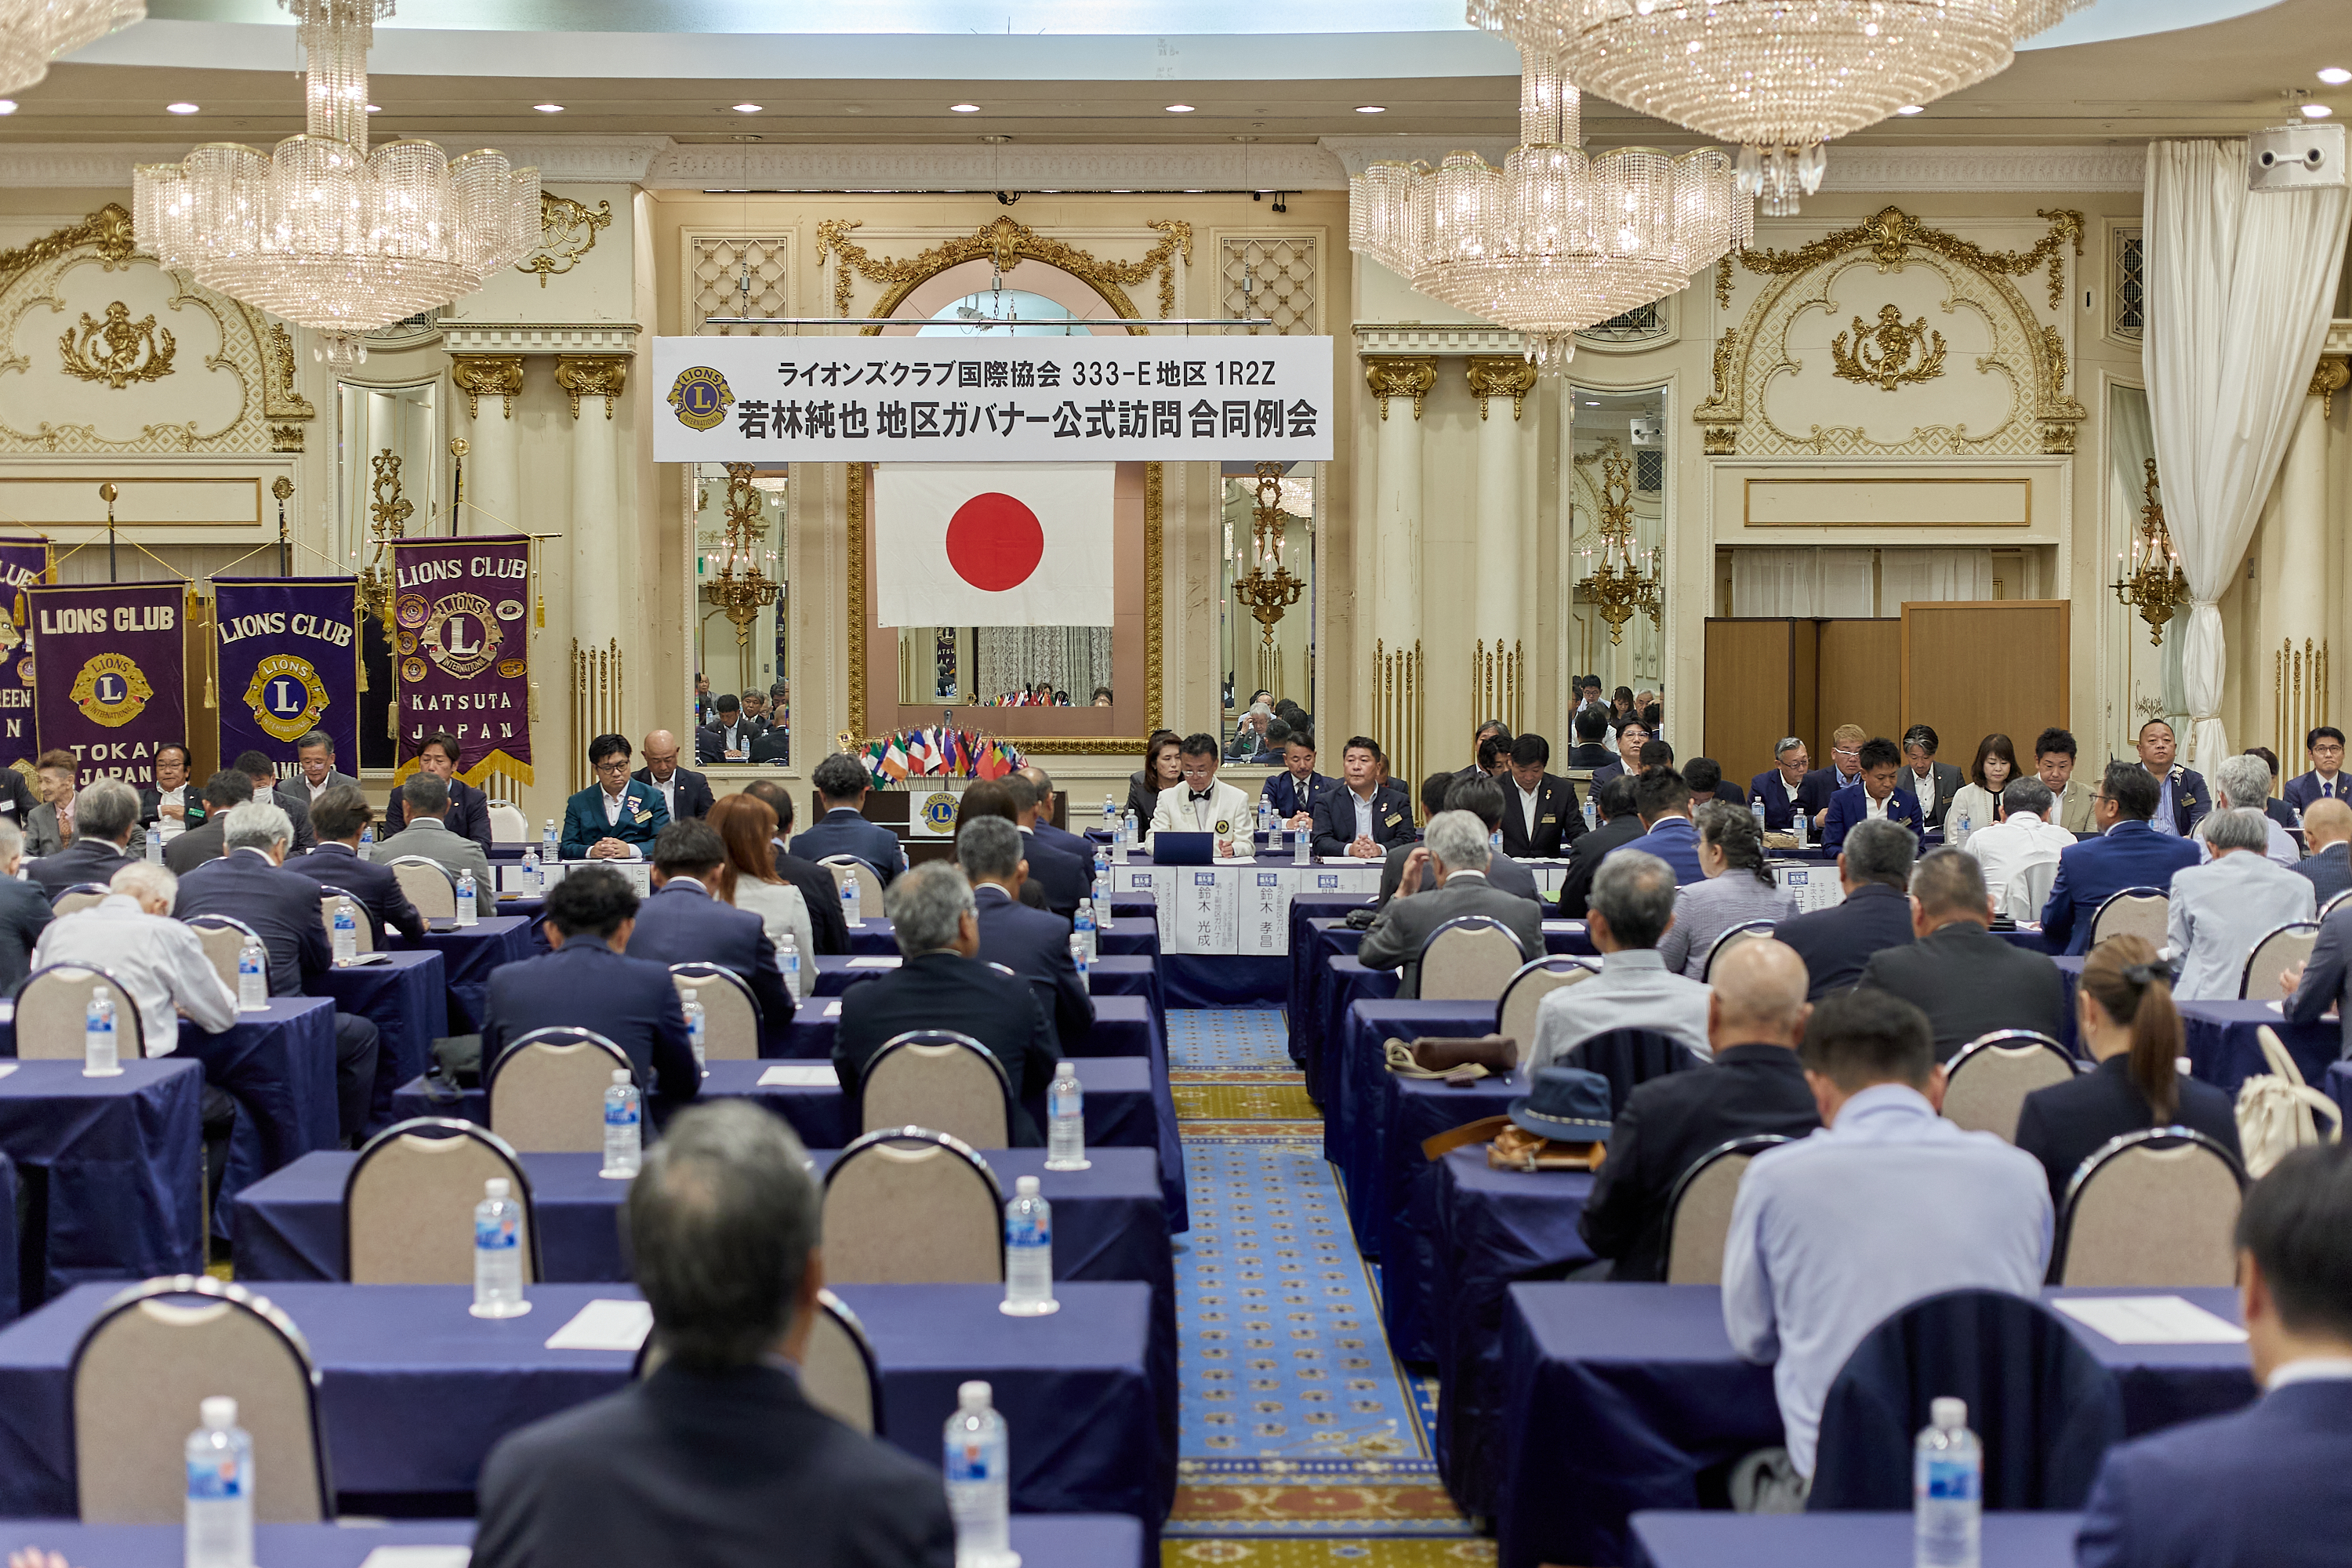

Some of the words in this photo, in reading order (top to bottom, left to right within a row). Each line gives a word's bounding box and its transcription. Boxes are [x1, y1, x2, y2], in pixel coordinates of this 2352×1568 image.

[681, 368, 720, 383] LIONS
[779, 360, 1062, 388] ライオンズクラブ国際協会
[694, 387, 712, 408] L
[682, 414, 720, 426] INTERNATIONAL
[397, 558, 462, 589] LIONS
[470, 556, 527, 580] CLUB
[440, 597, 485, 615] LIONS
[41, 608, 107, 634] LIONS
[114, 606, 174, 632] CLUB
[218, 612, 286, 645] LIONS
[291, 613, 353, 648] CLUB
[449, 617, 481, 654] L
[91, 658, 129, 673] LIONS
[263, 659, 308, 677] LIONS
[442, 657, 488, 673] INTERNATIONAL
[100, 677, 122, 701] L
[273, 681, 299, 712] L
[0, 689, 31, 708] EEN
[412, 691, 512, 711] KATSUTA
[89, 704, 134, 719] INTERNATIONAL
[263, 717, 310, 732] INTERNATIONAL
[930, 794, 955, 803] LIONS
[937, 805, 949, 820] L
